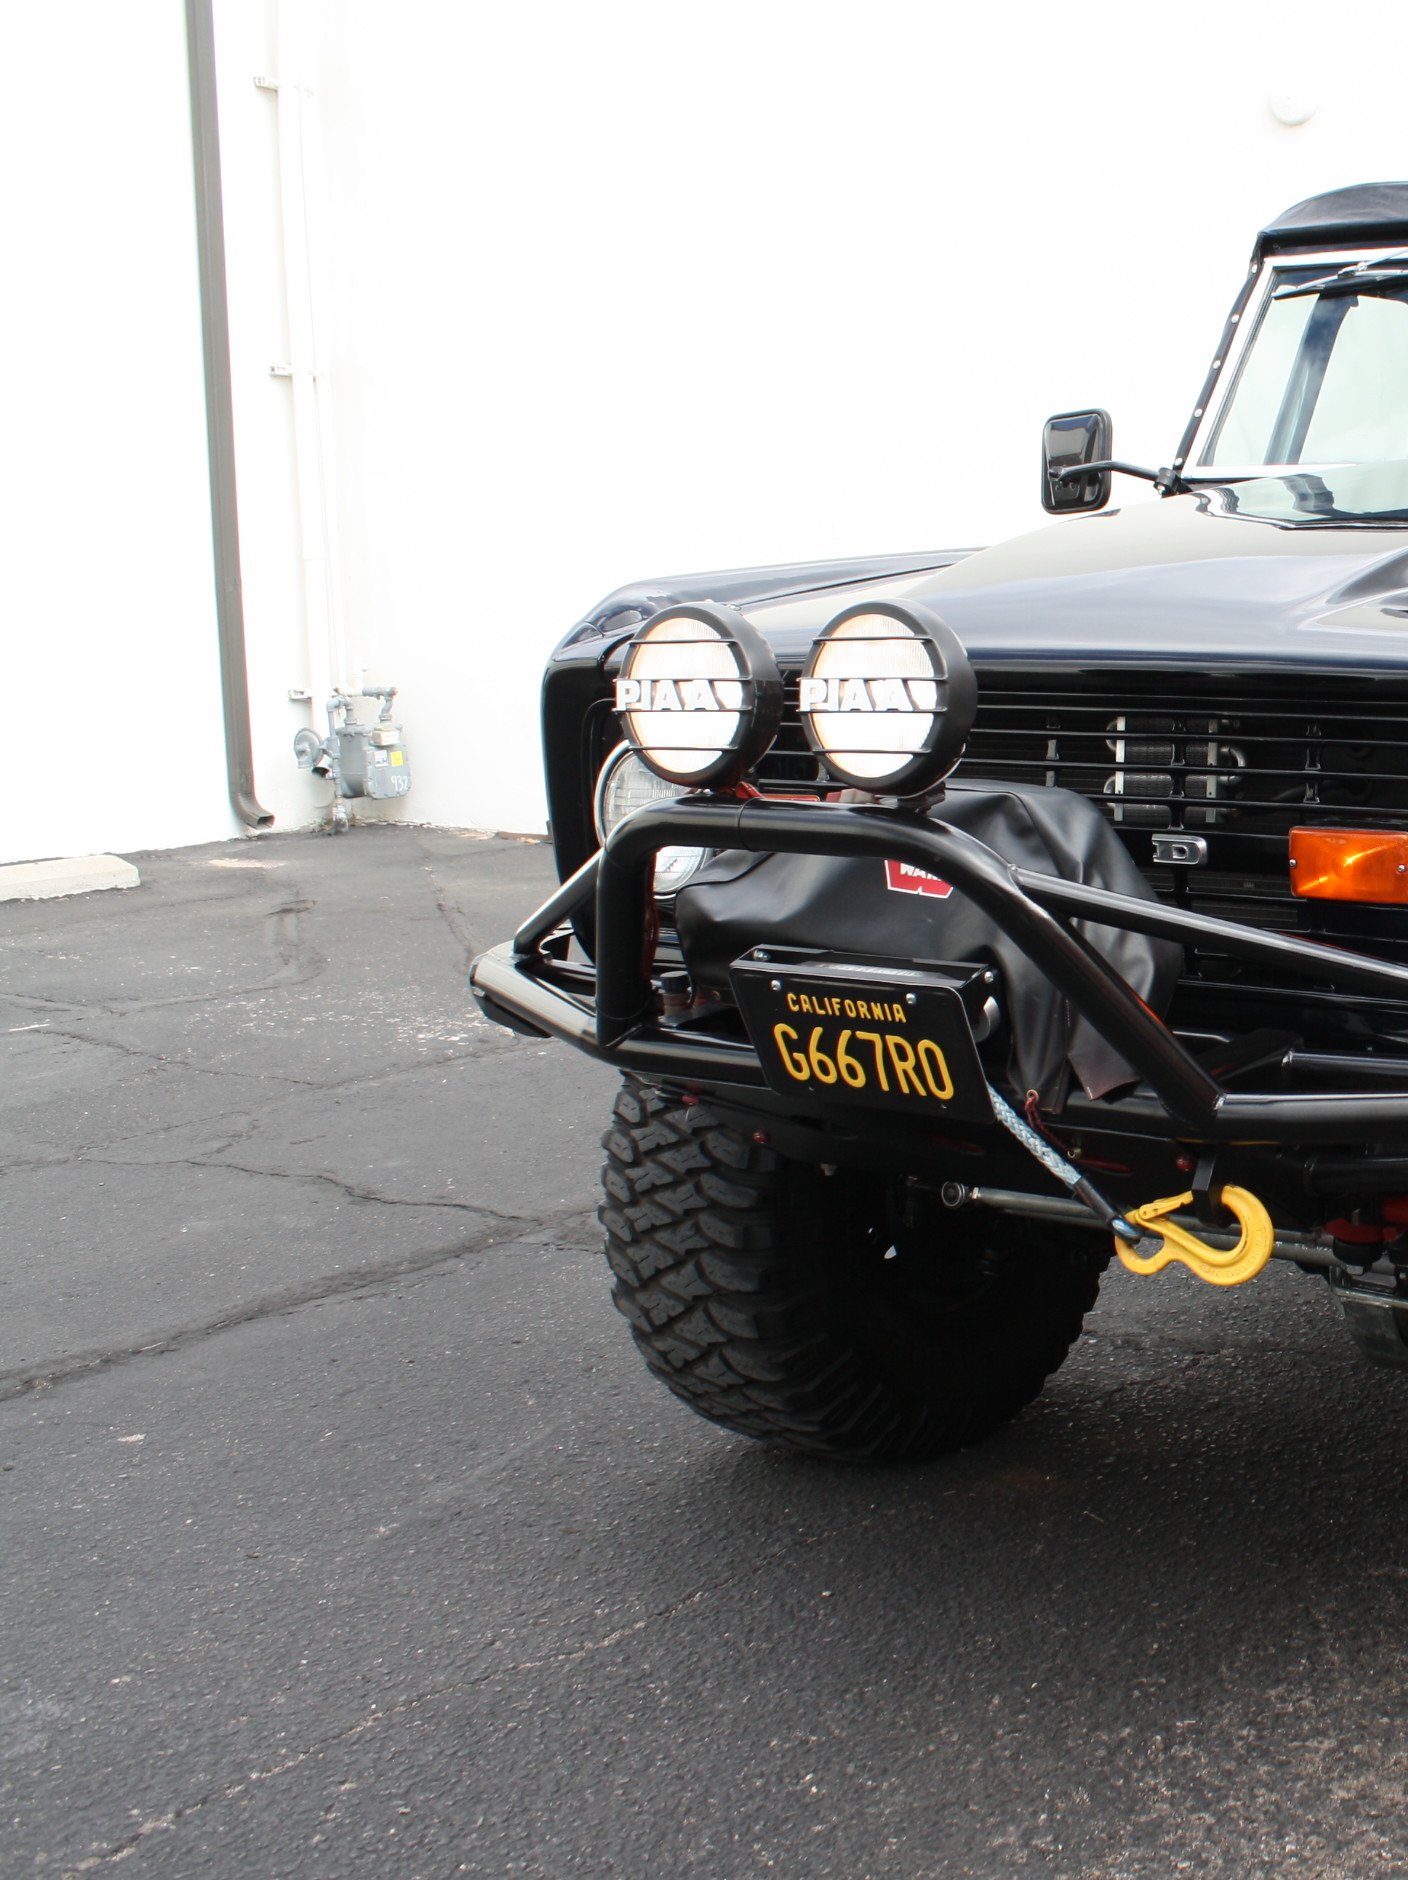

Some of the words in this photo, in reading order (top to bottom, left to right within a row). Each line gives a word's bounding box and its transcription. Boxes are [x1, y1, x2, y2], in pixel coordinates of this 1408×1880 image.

[615, 679, 720, 711] PIAA
[800, 678, 914, 712] PIAA
[786, 992, 907, 1023] CALIFORNIA
